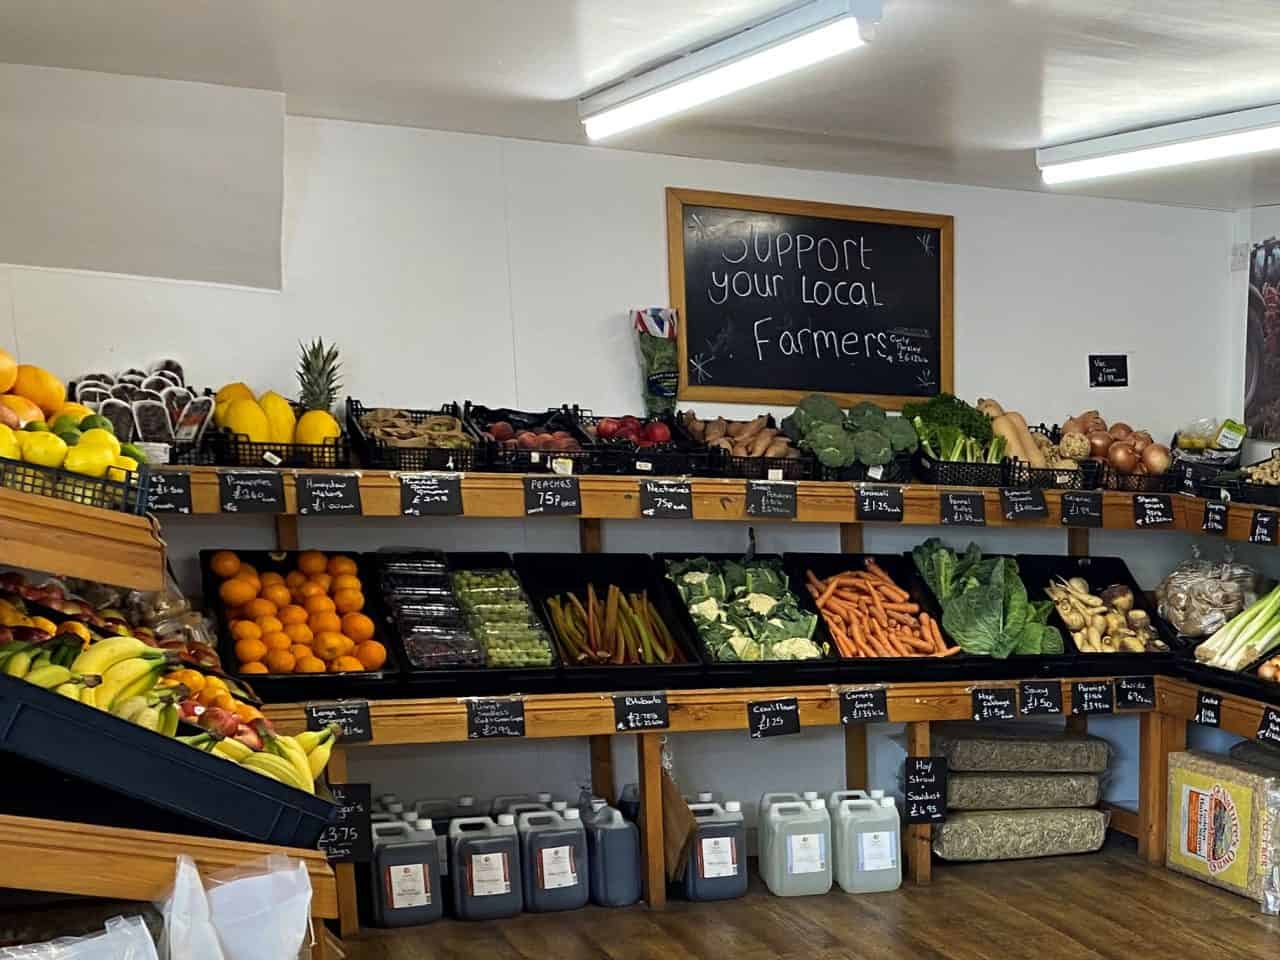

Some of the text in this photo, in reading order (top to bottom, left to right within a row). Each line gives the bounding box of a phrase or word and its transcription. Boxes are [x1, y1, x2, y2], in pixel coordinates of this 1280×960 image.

[708, 271, 785, 305] your
[754, 317, 887, 361] Farmers
[535, 491, 561, 506] 75p
[916, 760, 933, 773] Hay
